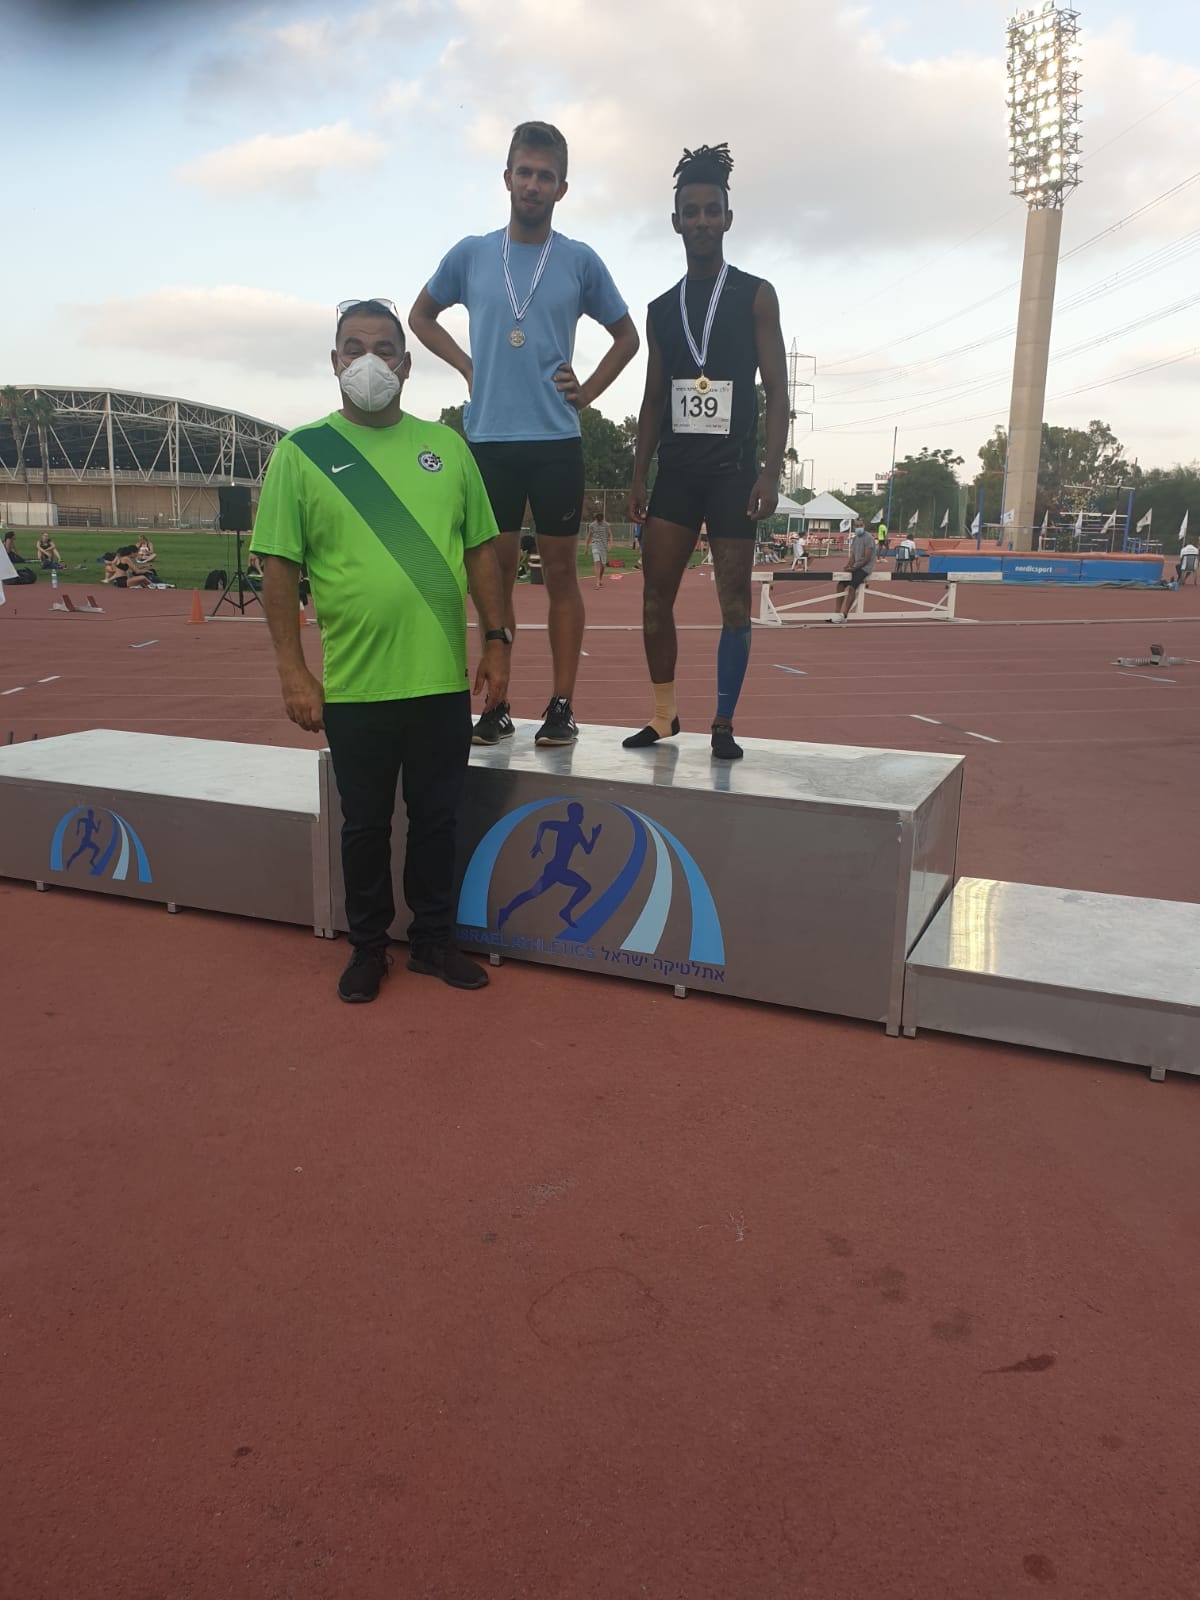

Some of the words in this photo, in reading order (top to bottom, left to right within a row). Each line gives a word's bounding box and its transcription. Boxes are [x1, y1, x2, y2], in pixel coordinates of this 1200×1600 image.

[681, 395, 718, 418] 139
[511, 935, 596, 960] ATHLETICS
[601, 945, 648, 967] ישראל
[653, 958, 725, 983] אתלטיקה
